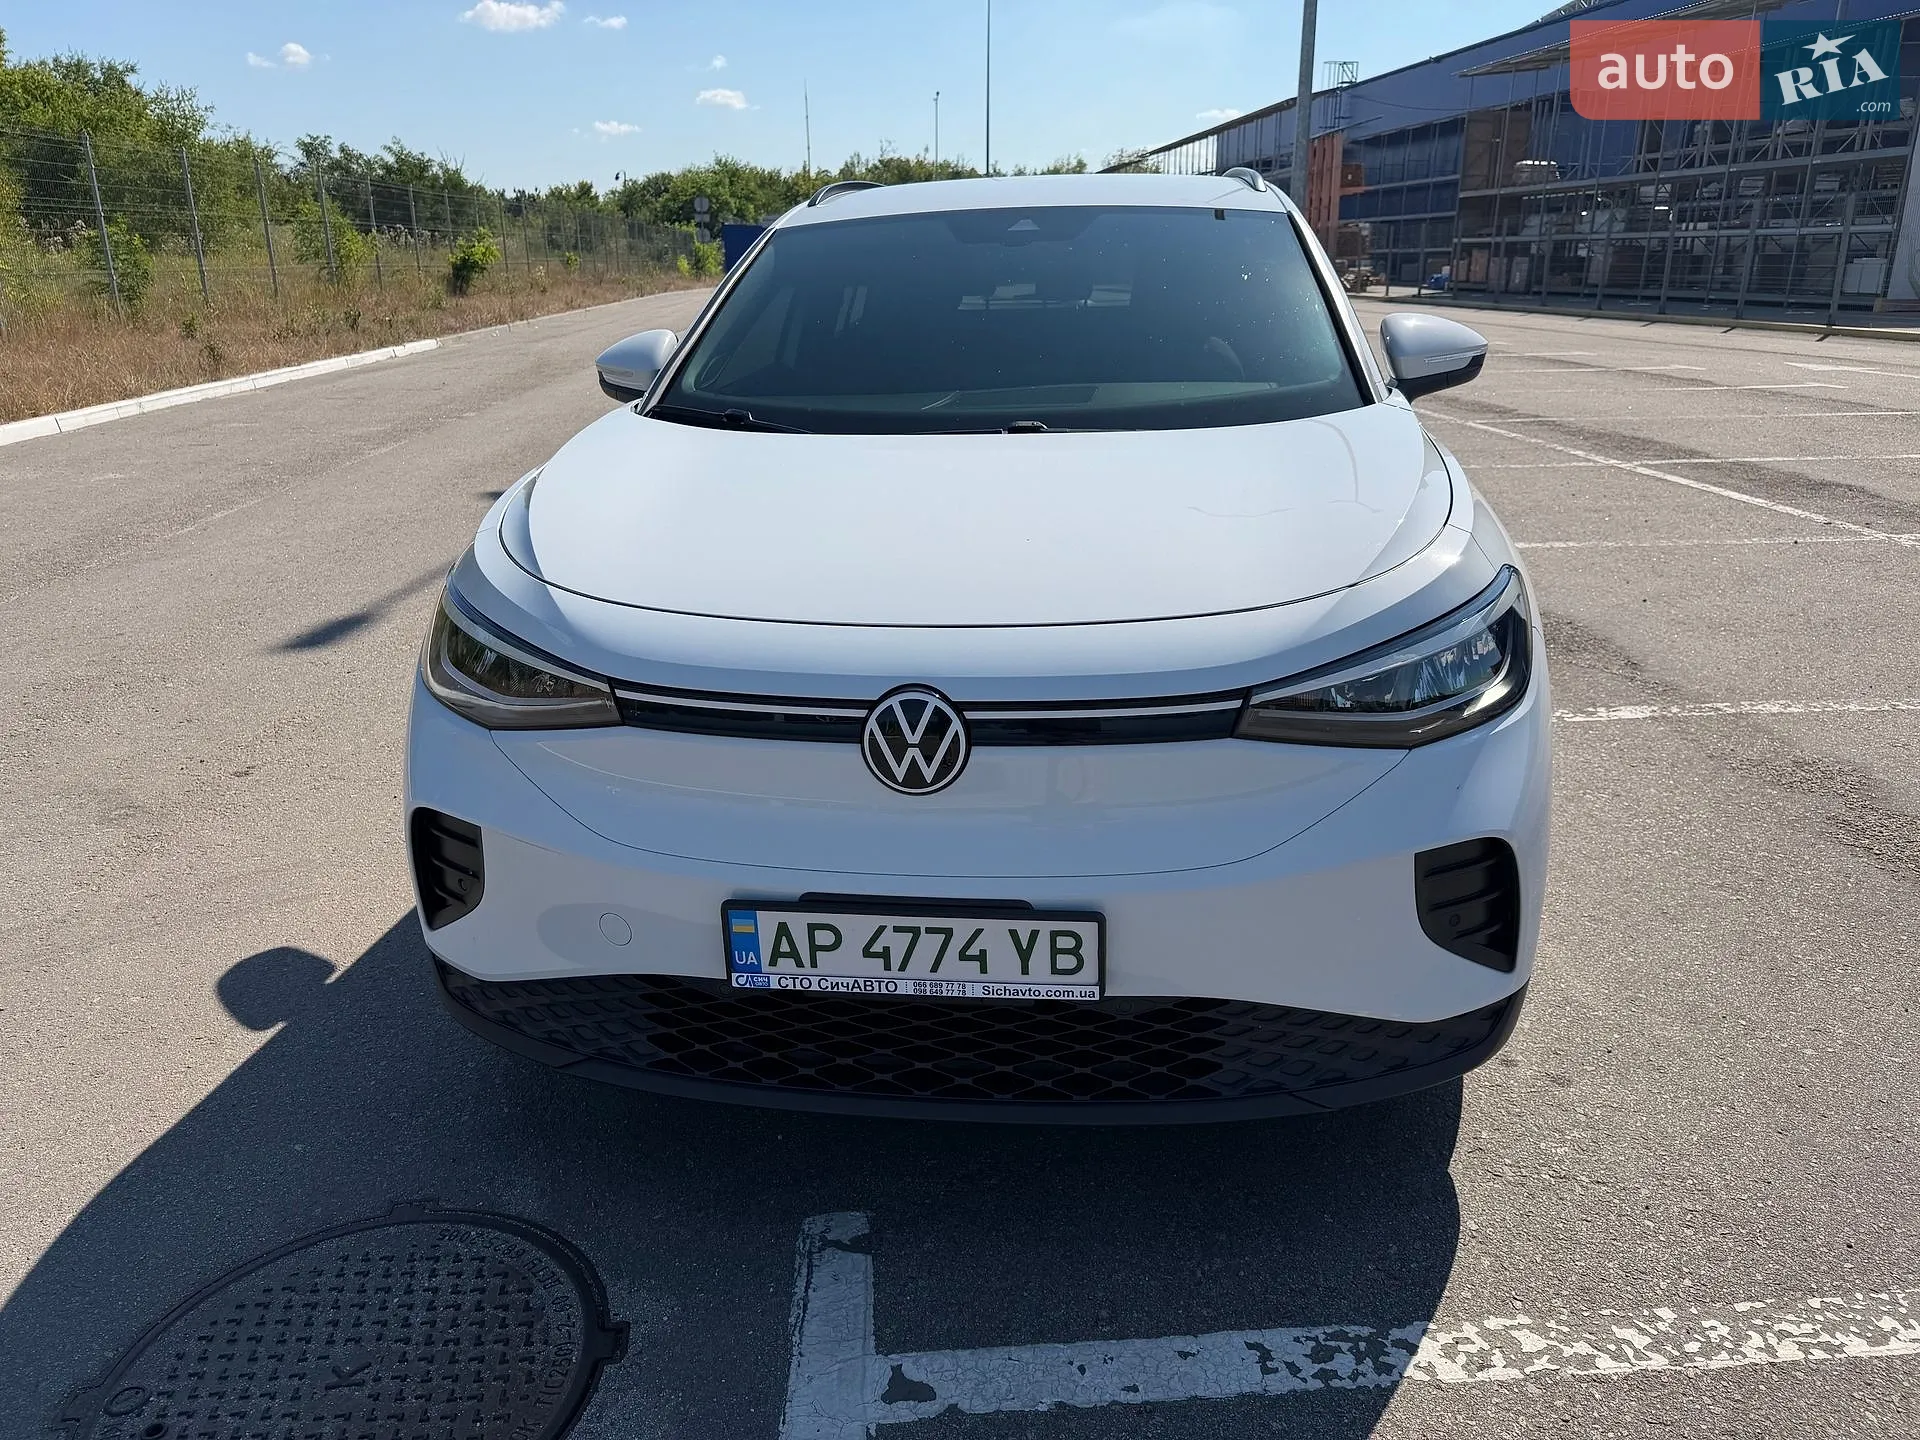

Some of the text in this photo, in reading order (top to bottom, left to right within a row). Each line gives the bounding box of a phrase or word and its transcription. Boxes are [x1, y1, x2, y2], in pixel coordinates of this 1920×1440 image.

[768, 921, 1085, 976] AP 4774 YB
[734, 950, 759, 965] UA
[777, 976, 899, 993] СТО СичАВТО
[981, 985, 1096, 999] Sichavto.com.ua
[956, 989, 967, 997] 78
